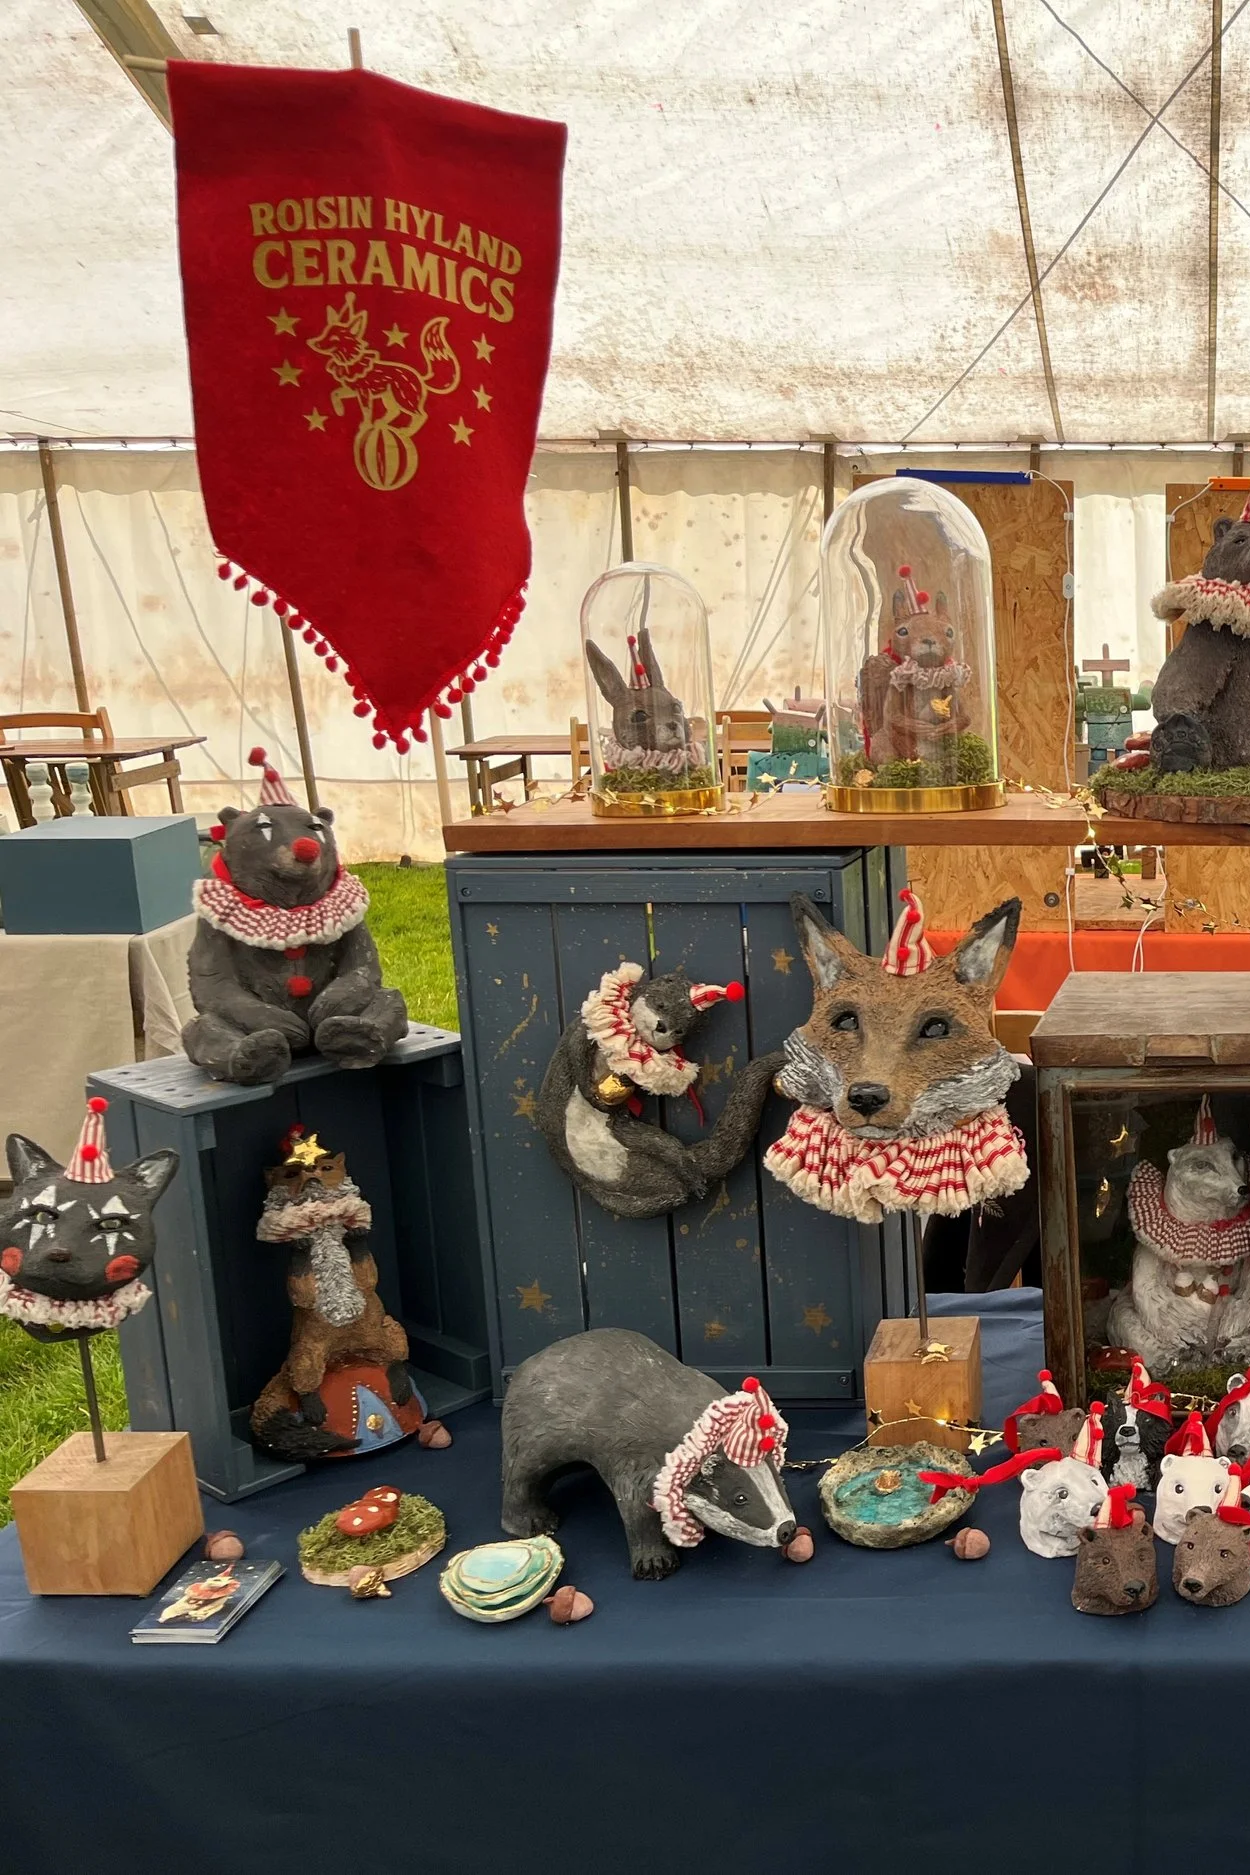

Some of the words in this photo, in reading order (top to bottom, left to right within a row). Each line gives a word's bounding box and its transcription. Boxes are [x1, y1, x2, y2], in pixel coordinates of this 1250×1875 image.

[248, 196, 373, 236] ROISIN
[384, 197, 523, 276] HYLAND
[252, 239, 515, 323] CERAMICS
